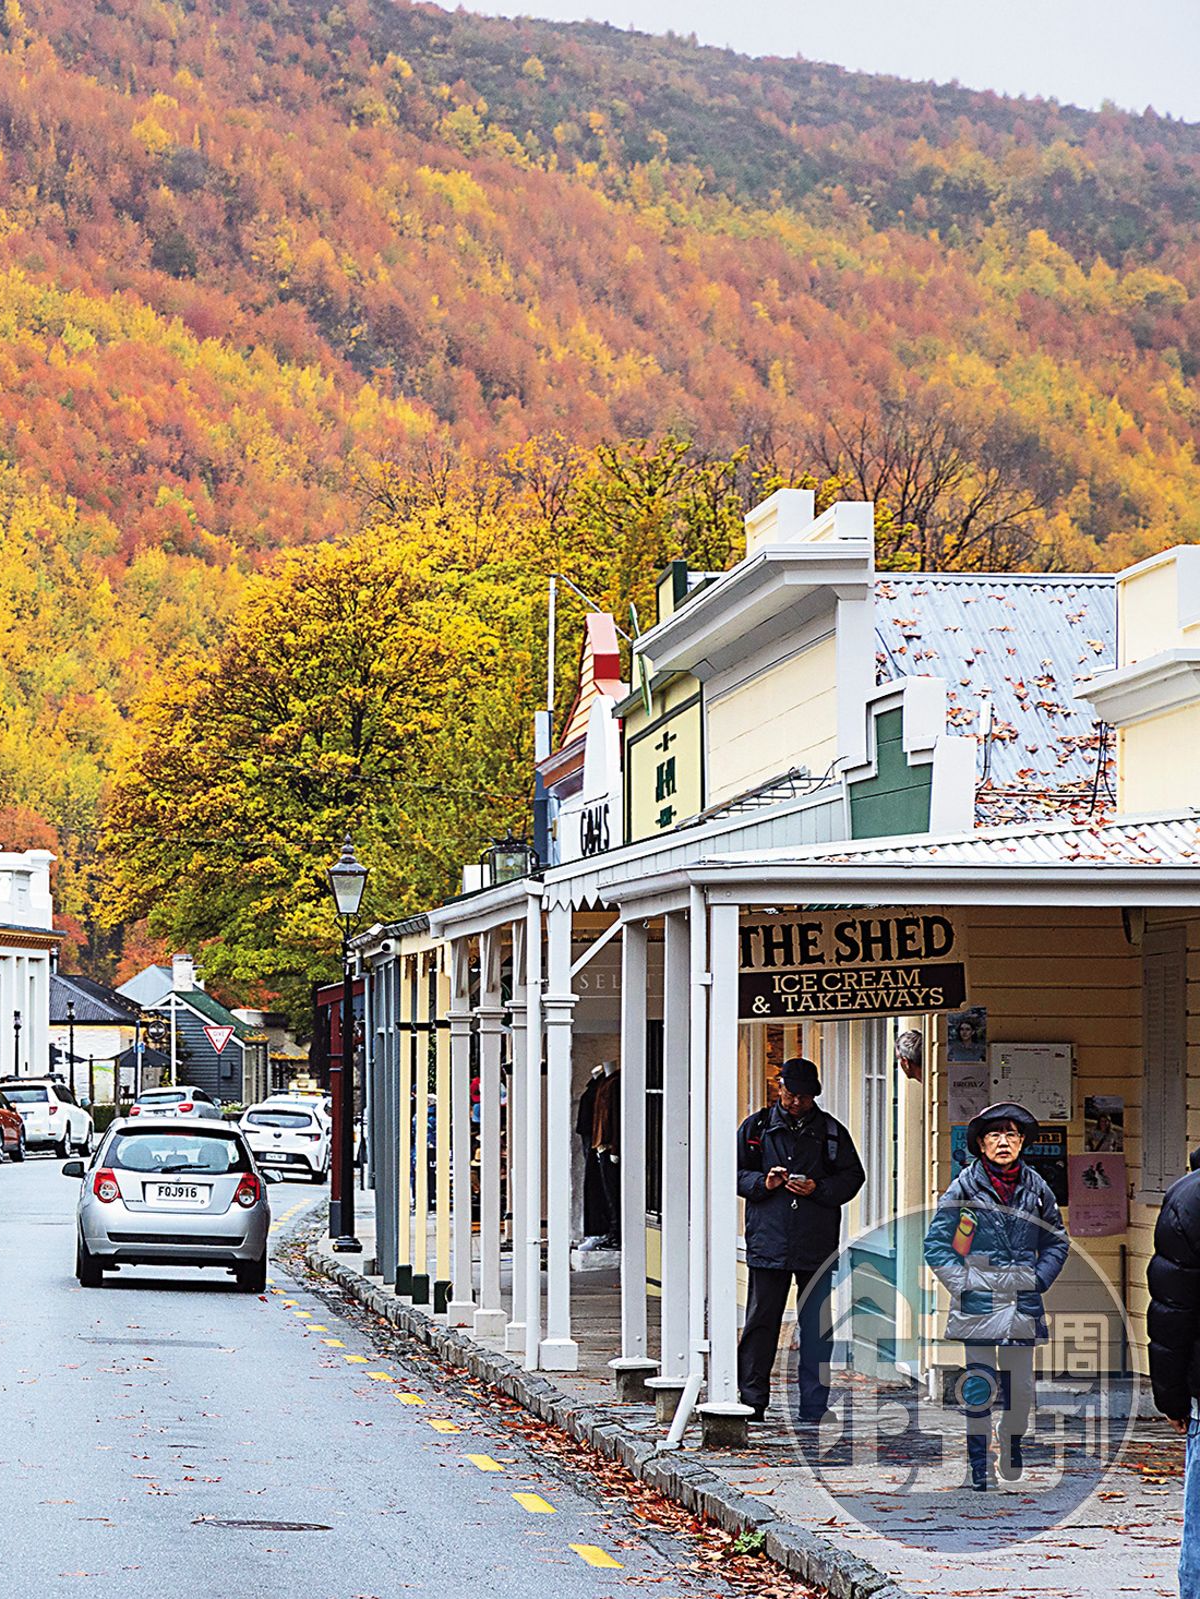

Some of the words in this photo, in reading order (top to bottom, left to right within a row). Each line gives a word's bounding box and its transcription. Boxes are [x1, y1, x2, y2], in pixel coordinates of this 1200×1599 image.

[738, 920, 827, 968] THE
[834, 915, 955, 967] SHED
[772, 974, 818, 994] ICE
[822, 968, 921, 991] CREAM
[752, 995, 771, 1014] &
[781, 987, 945, 1013] TAKEAWAYS
